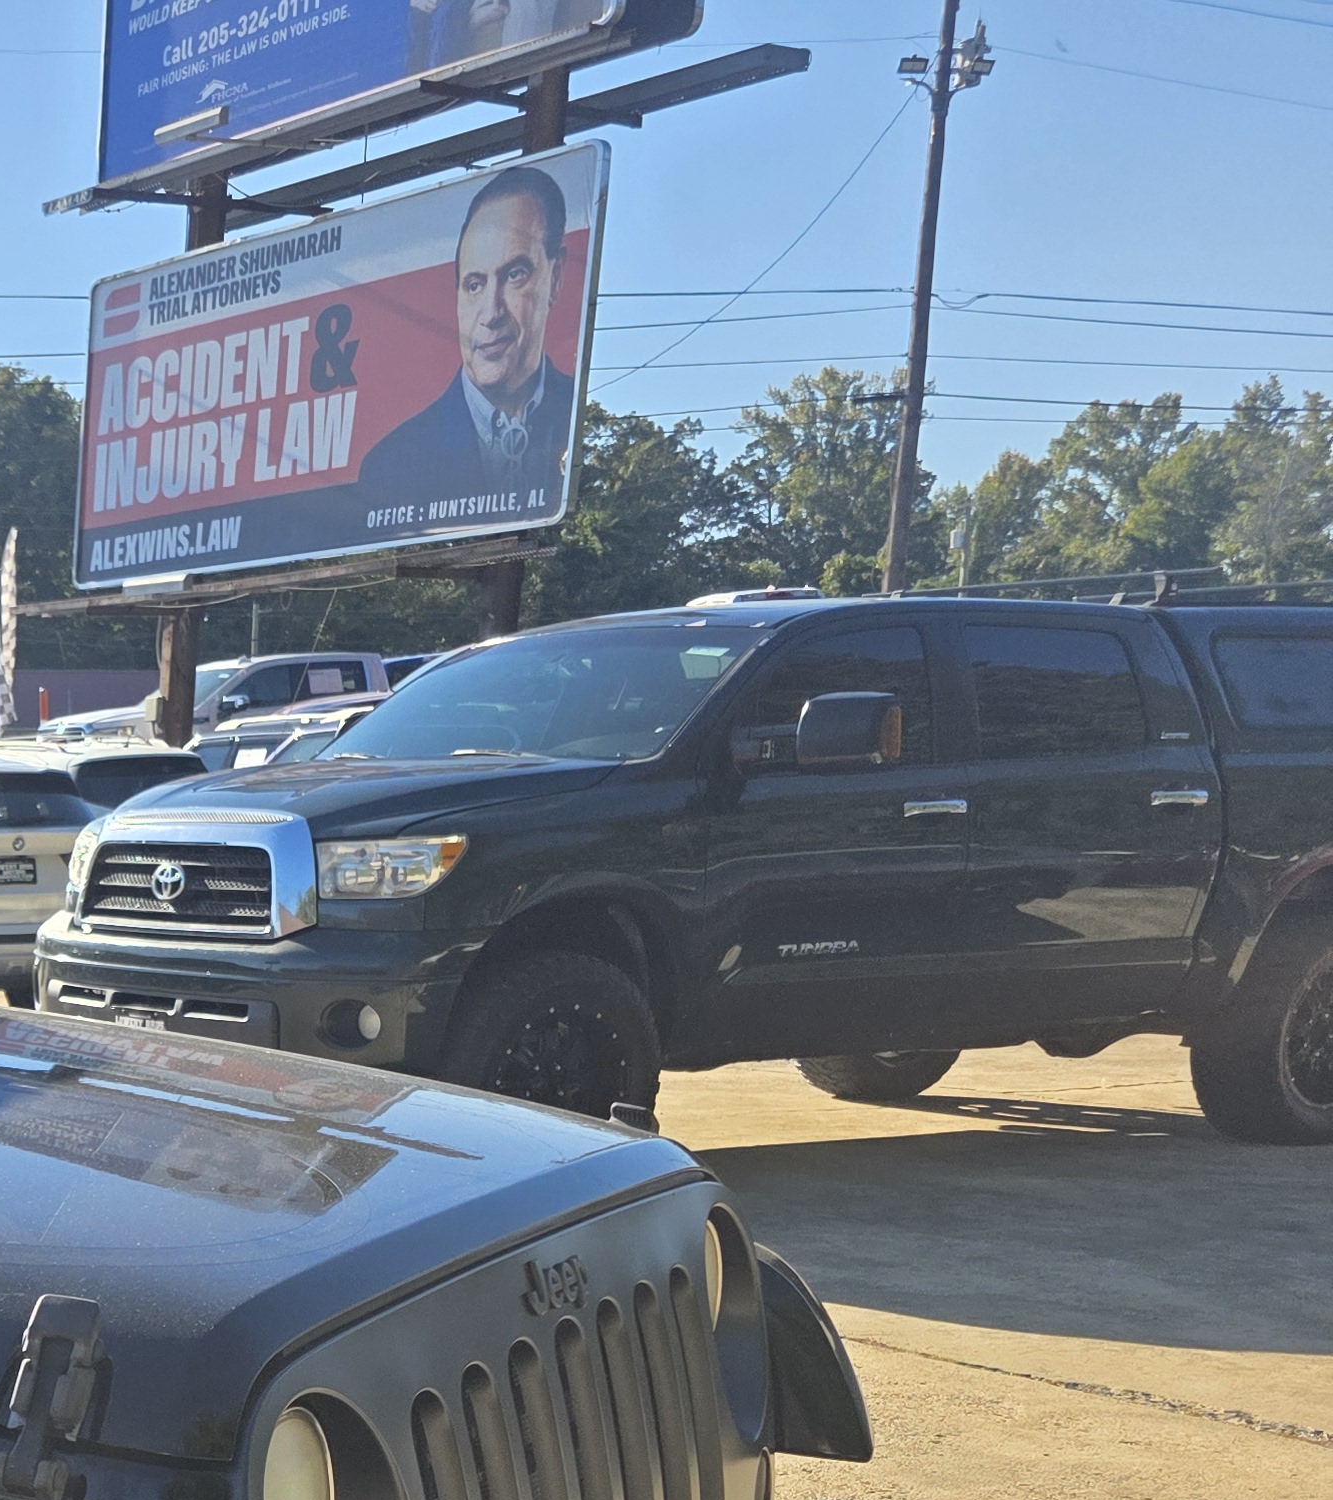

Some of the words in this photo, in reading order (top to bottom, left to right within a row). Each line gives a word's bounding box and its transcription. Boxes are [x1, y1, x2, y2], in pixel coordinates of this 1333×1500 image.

[128, 4, 170, 36] WOULD
[137, 78, 160, 98] FAIR
[161, 59, 209, 87] HOUSING:
[211, 49, 231, 69] THE
[234, 38, 258, 60] LAW
[259, 35, 270, 50] IS
[272, 27, 287, 45] ON
[290, 16, 319, 38] YOUR
[321, 4, 351, 27] SIDE.
[163, 37, 193, 67] Call
[149, 255, 236, 301] ALEXANDER
[239, 226, 342, 276] SHUNNARAH
[149, 297, 188, 326] TRIAL
[191, 270, 281, 315] ATTORNEYS
[98, 316, 309, 436] ACCIDENT
[309, 303, 358, 393] &
[93, 413, 245, 512] INJURY
[254, 391, 357, 482] LAW
[367, 505, 415, 528] OFFICE
[429, 491, 521, 520] HUNTSVILLE,
[527, 488, 546, 508] AL
[90, 516, 242, 572] ALEXWINS.LAW
[777, 940, 859, 957] TUNDRA
[519, 1254, 589, 1316] Jeep
